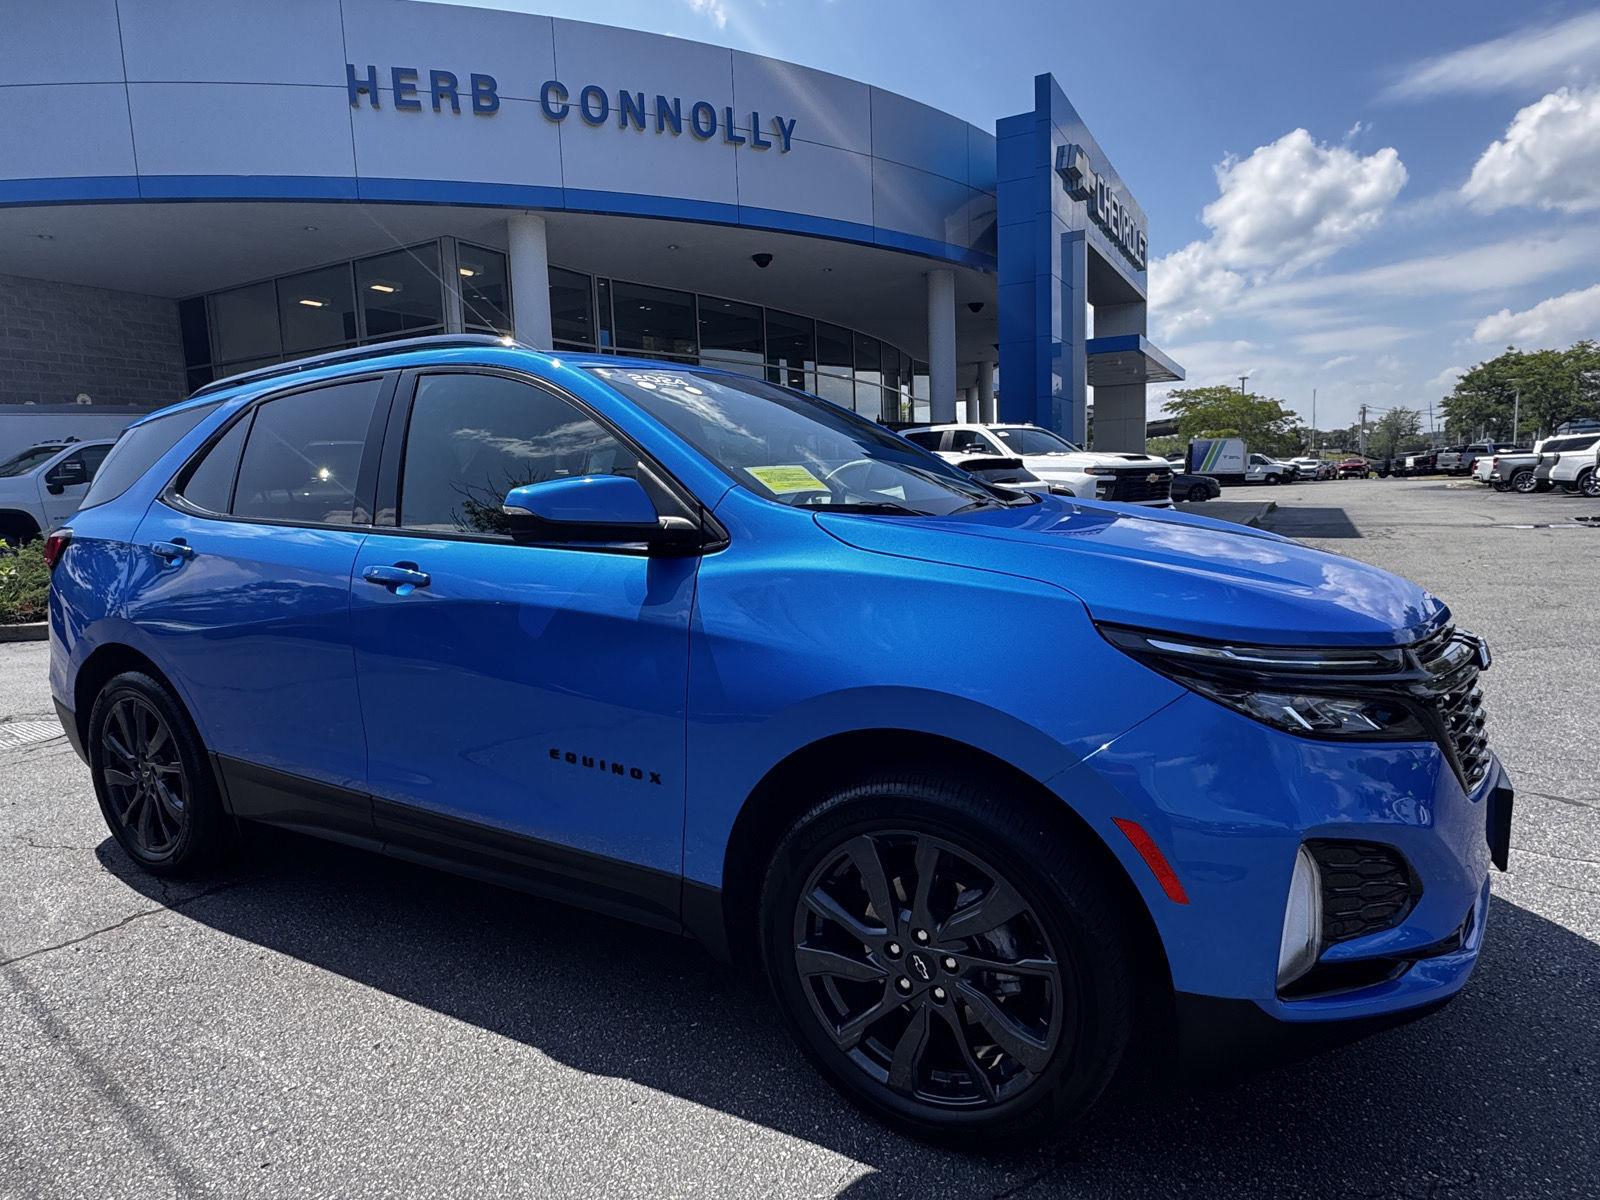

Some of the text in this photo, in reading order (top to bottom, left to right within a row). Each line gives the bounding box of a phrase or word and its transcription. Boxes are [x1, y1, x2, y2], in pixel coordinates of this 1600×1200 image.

[346, 63, 797, 154] HERB CONNOLLY
[627, 373, 689, 387] 2024
[548, 748, 662, 785] EQUINOX
